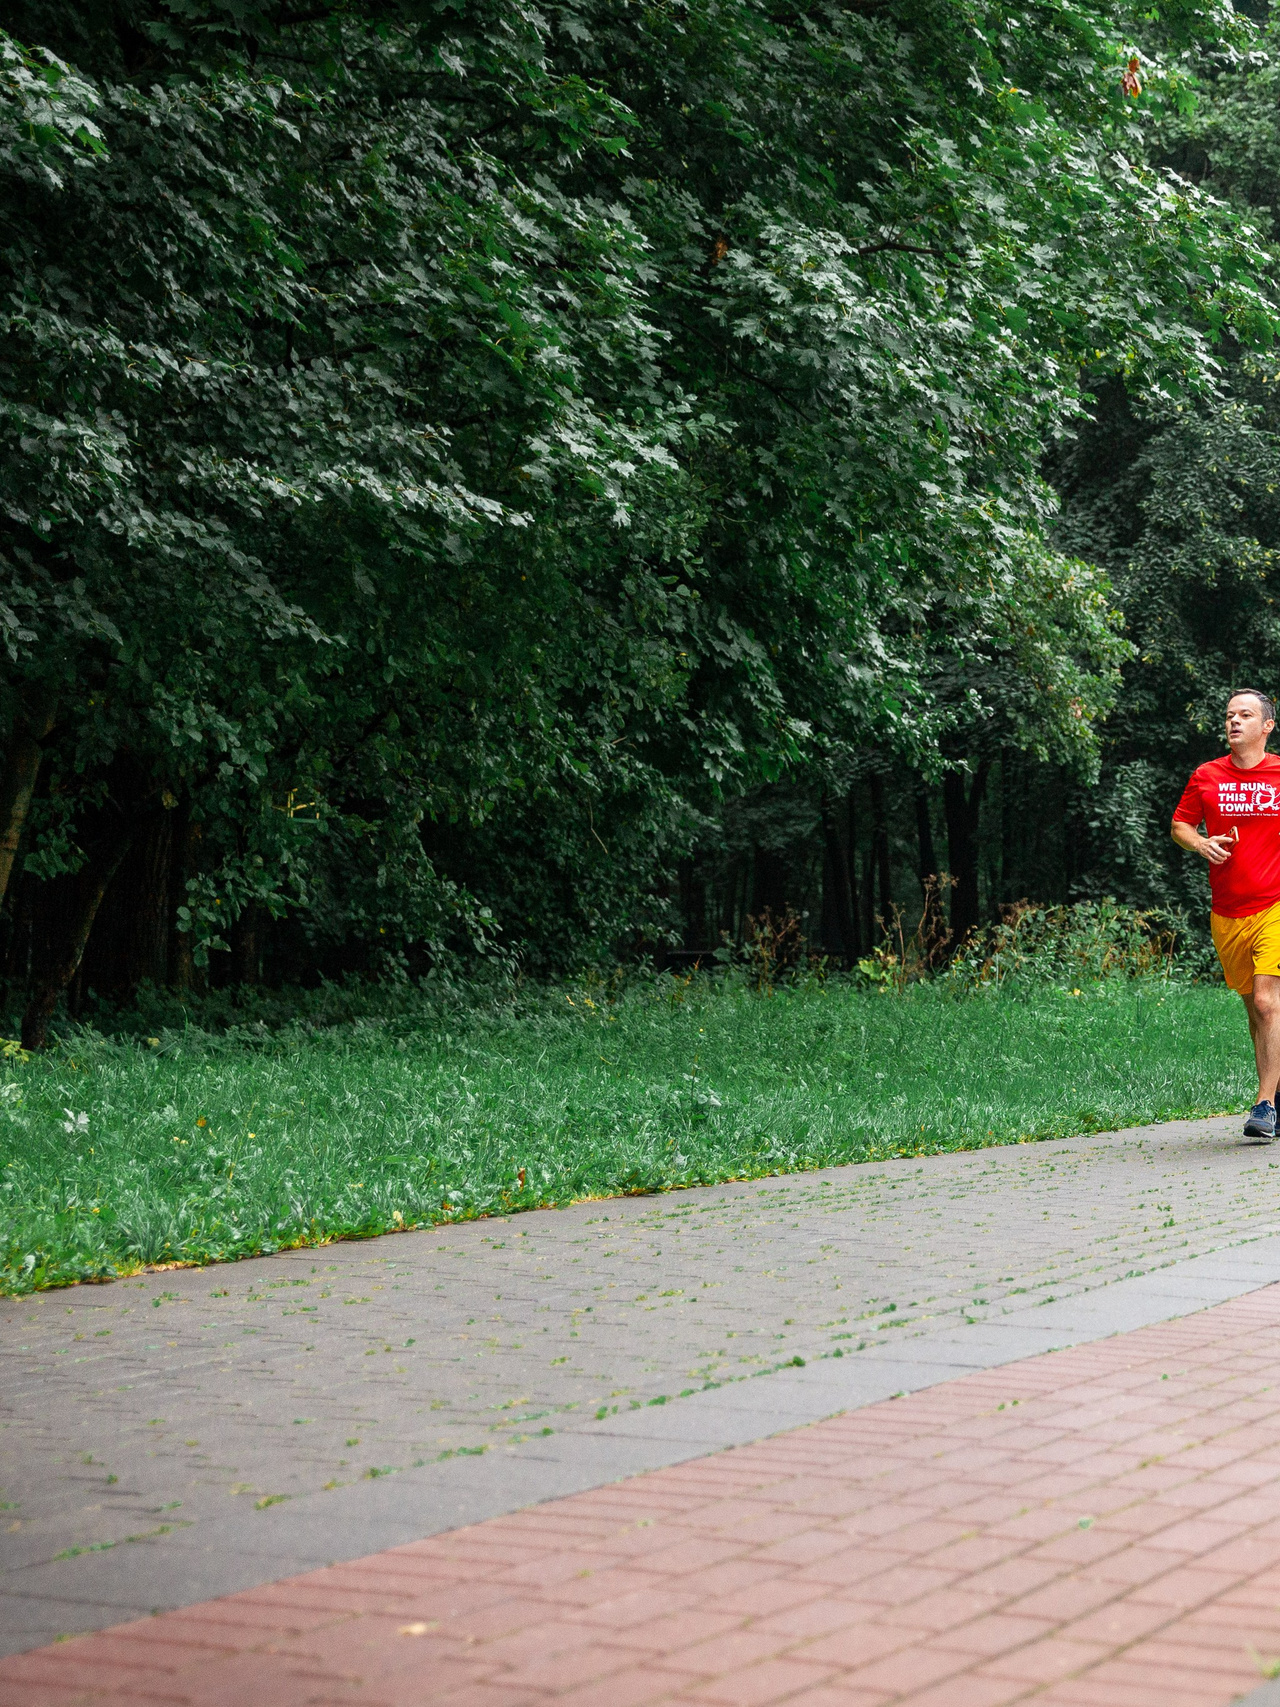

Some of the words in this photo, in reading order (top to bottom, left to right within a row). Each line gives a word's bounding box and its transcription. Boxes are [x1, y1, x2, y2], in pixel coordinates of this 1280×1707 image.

[1218, 782, 1237, 791] WE
[1240, 782, 1266, 791] RUN
[1218, 793, 1247, 802] THIS
[1218, 803, 1254, 812] TOWN
